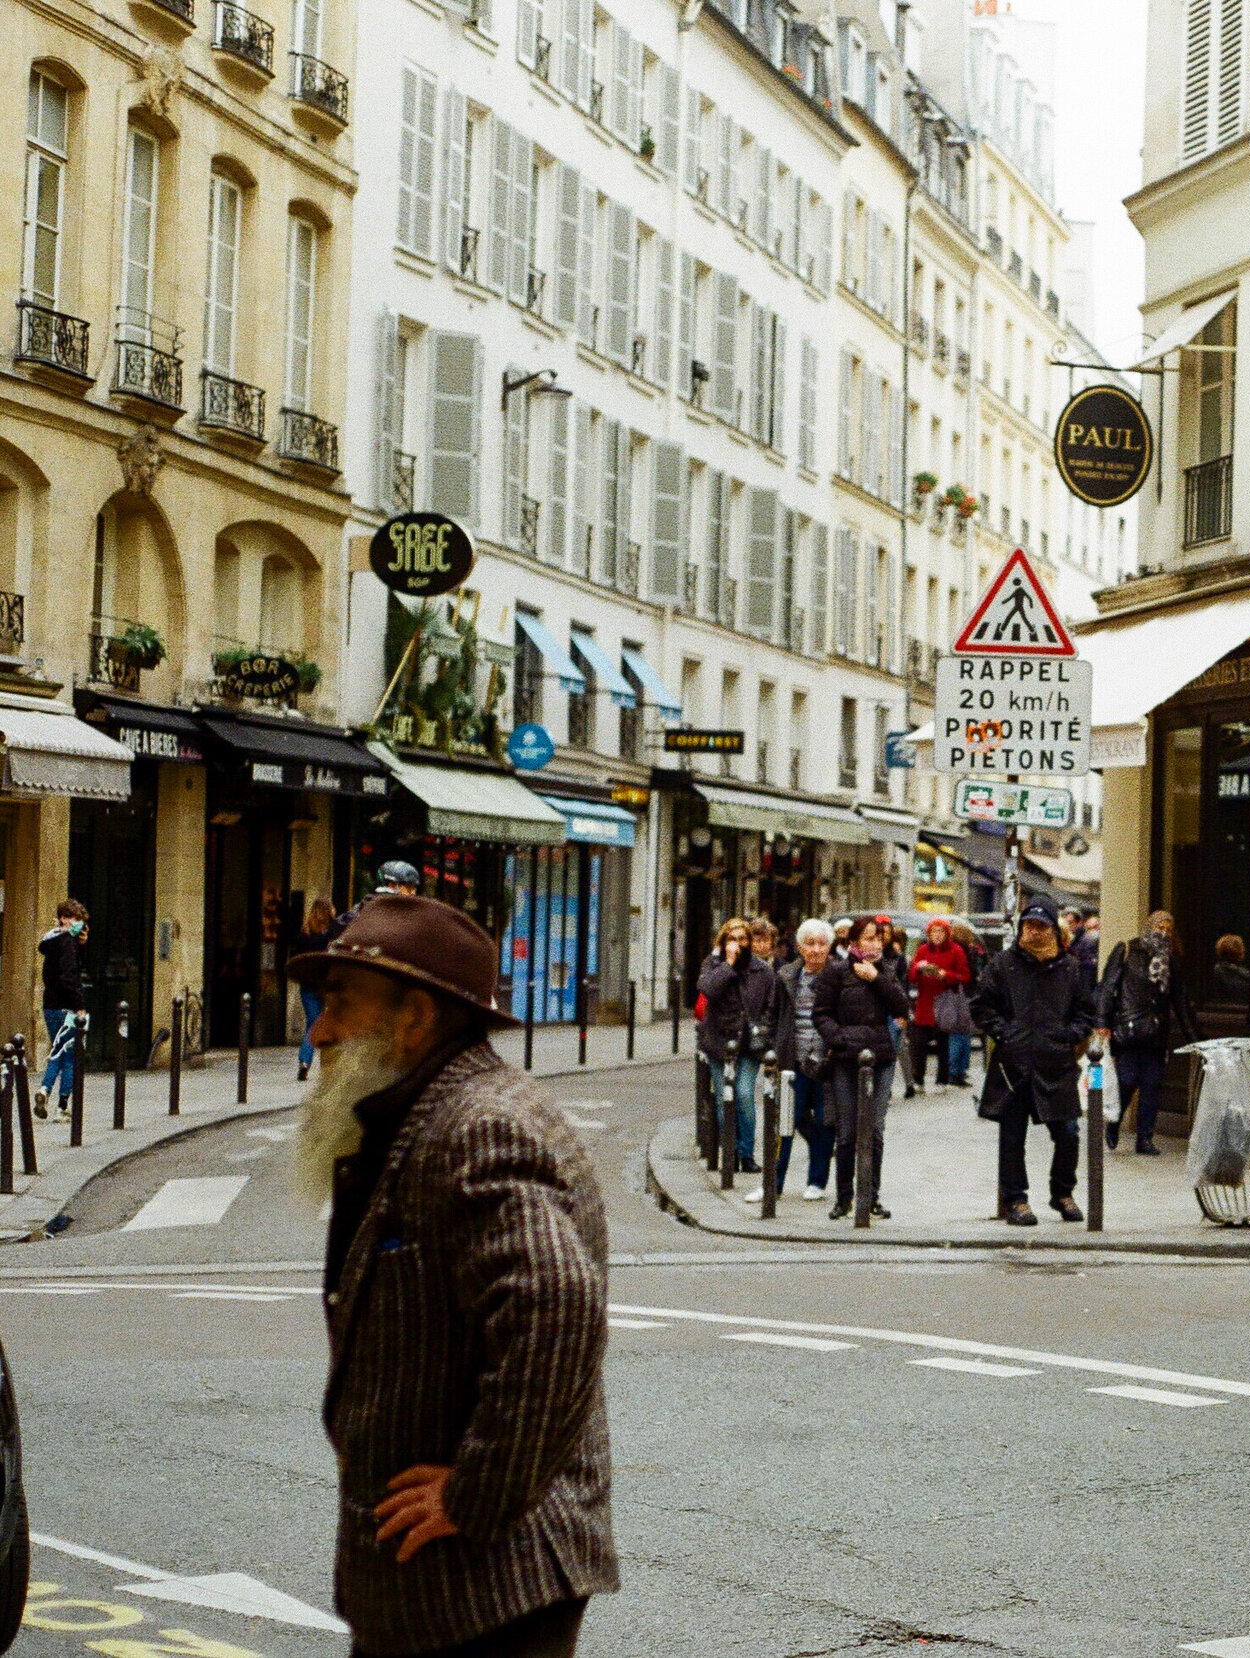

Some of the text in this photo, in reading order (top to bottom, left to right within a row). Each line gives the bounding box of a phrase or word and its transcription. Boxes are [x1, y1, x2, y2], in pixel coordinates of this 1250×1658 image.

[1067, 422, 1142, 451] PAUL
[959, 658, 1071, 683] RAPPEL
[959, 688, 1071, 712] 20 km/h
[945, 715, 1083, 742] PORITÉ
